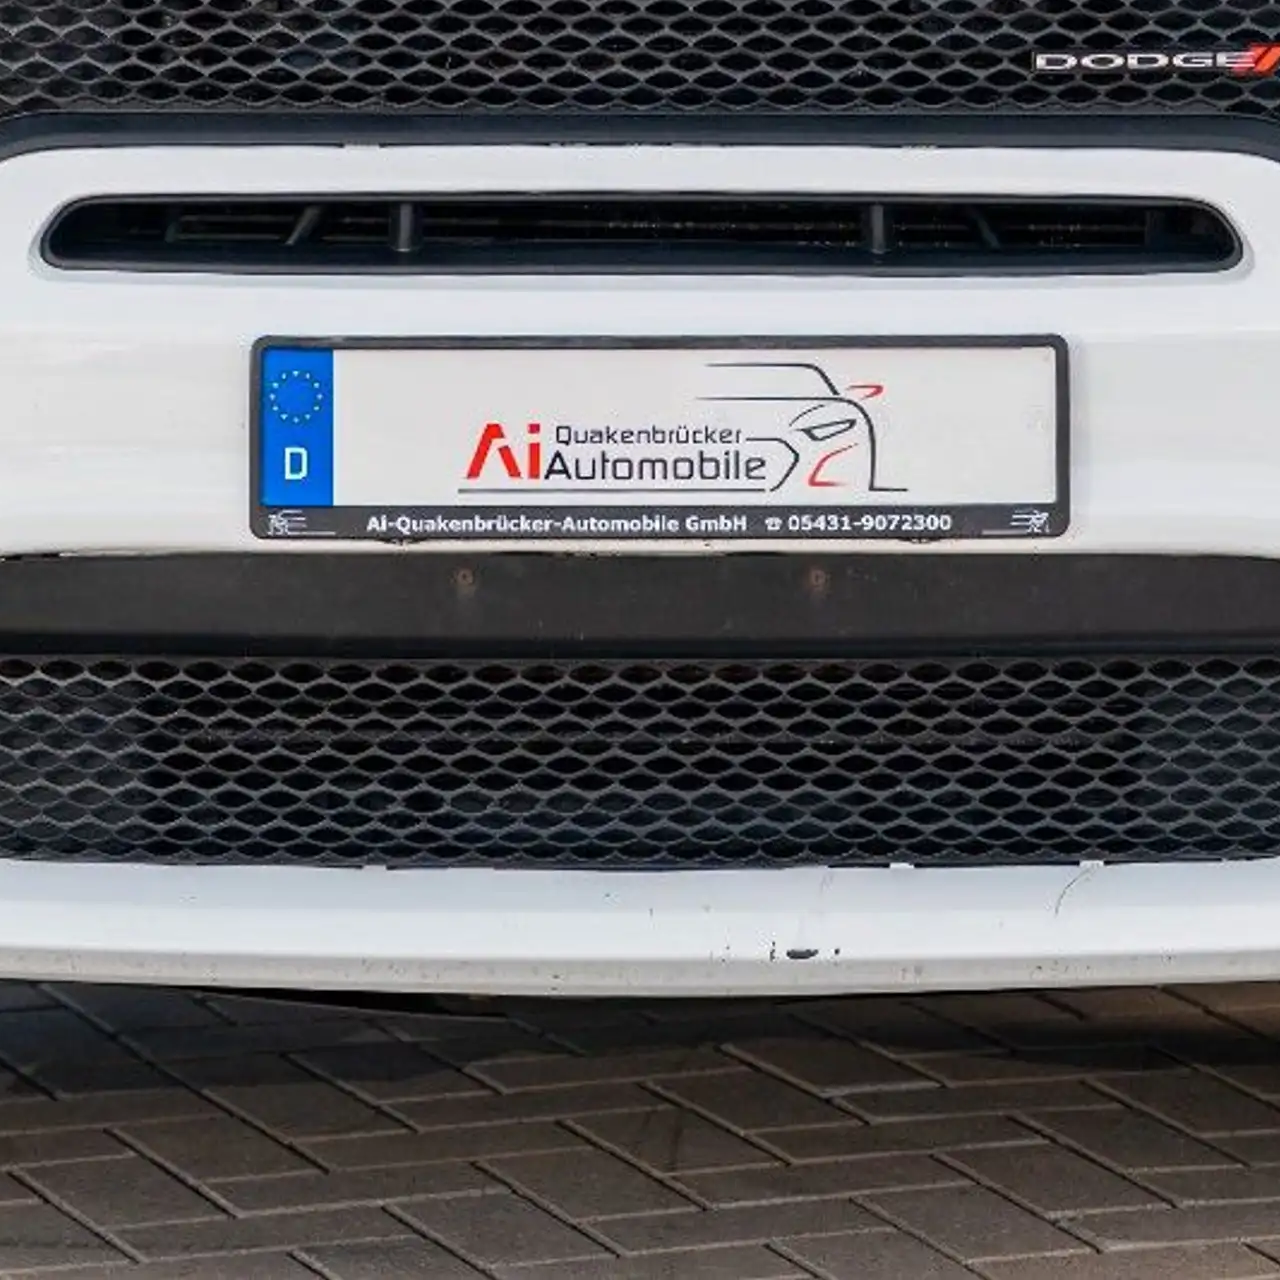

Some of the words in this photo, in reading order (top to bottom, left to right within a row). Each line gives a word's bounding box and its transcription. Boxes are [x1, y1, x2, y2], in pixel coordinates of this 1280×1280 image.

[1035, 52, 1255, 69] DODGE
[555, 424, 741, 446] Quakenbrücker
[284, 446, 308, 480] D
[544, 449, 767, 480] Automobile
[685, 515, 747, 532] GmbH
[787, 514, 952, 532] 05431-9072300
